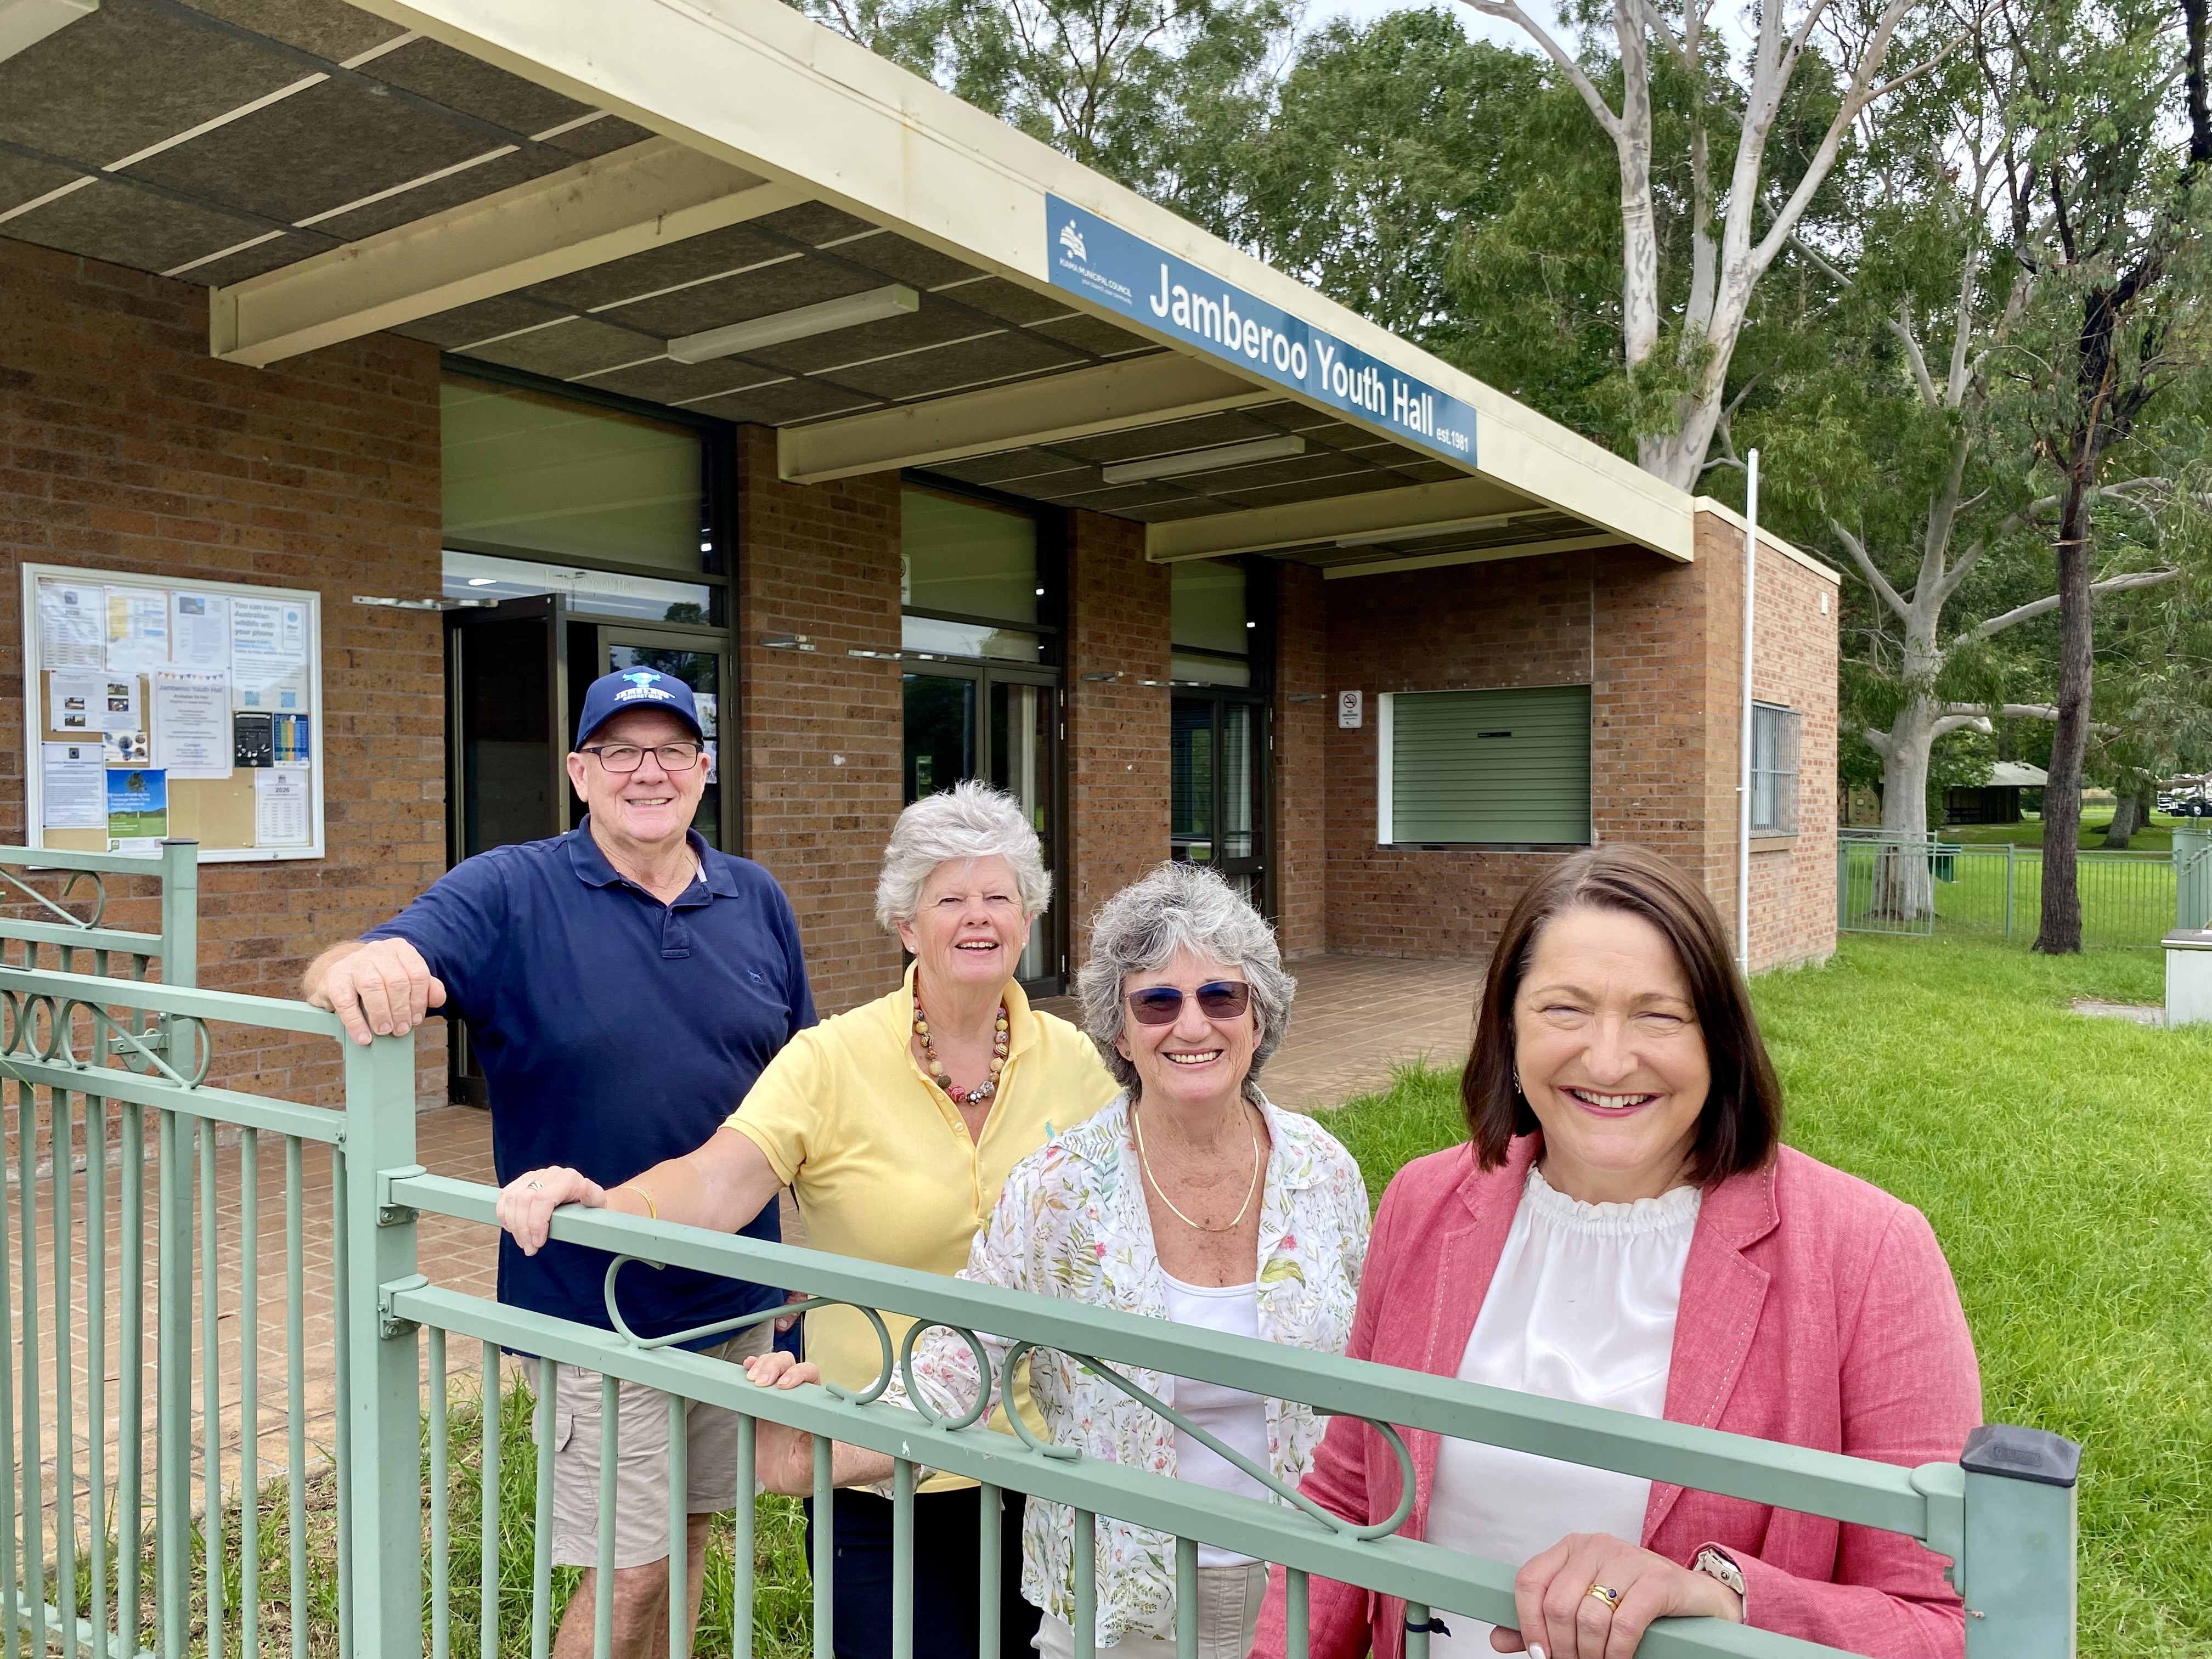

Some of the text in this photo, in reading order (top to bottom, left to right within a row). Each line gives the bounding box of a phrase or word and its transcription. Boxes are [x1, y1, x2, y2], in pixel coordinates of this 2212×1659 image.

[1059, 257, 1132, 297] KIAMA MUNICIPAL COUNCIL
[1149, 263, 1434, 437] Jamberoo Youth Hall
[1436, 428, 1469, 453] est.1981
[234, 611, 269, 619] Australian
[614, 687, 675, 701] JAMBEROO
